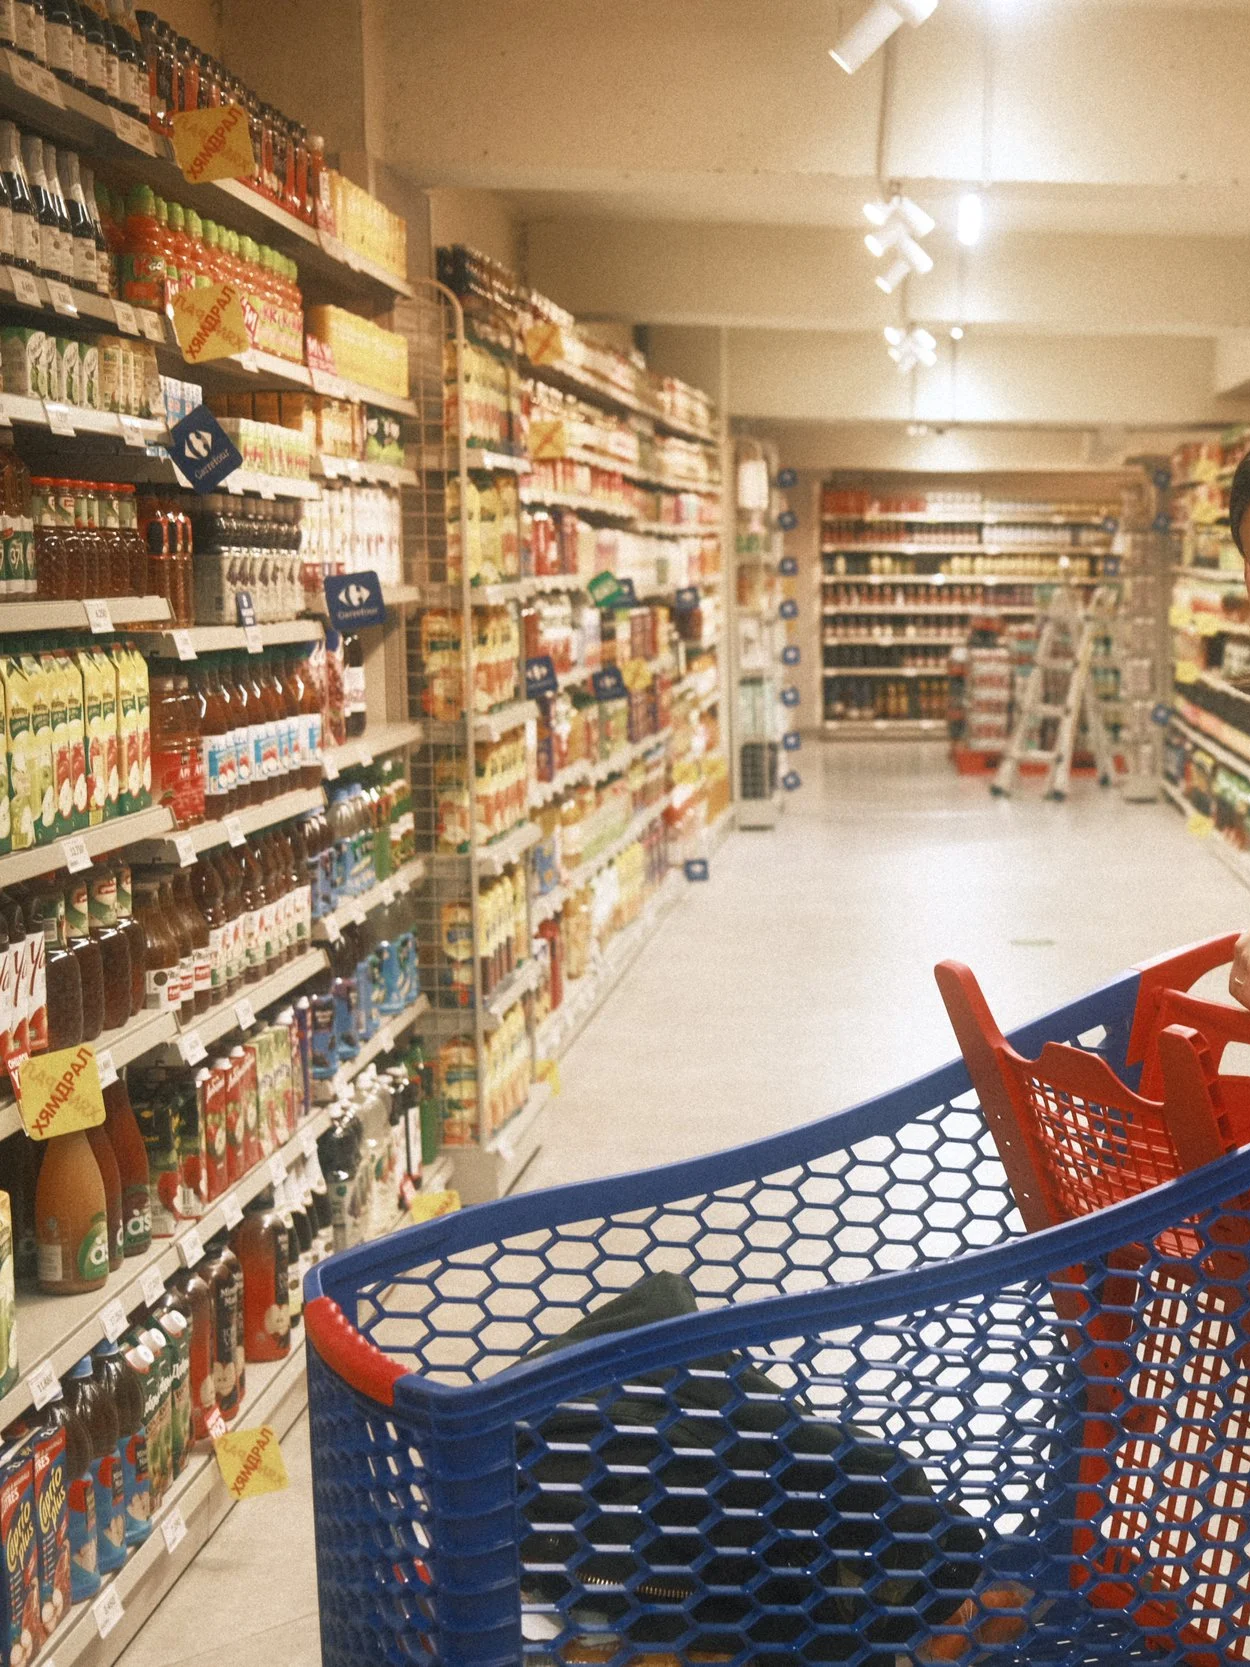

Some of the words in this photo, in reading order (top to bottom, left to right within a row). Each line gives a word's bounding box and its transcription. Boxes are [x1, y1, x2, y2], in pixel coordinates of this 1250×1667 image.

[186, 107, 242, 180] ХЯМДРАЛ
[185, 286, 236, 360] ХЯМДРАЛ
[195, 449, 232, 479] Carrefour
[337, 606, 379, 620] Carrefour
[32, 1047, 93, 1136] ХЯМДРАЛ
[231, 1427, 274, 1496] ХЯМДРАЛ
